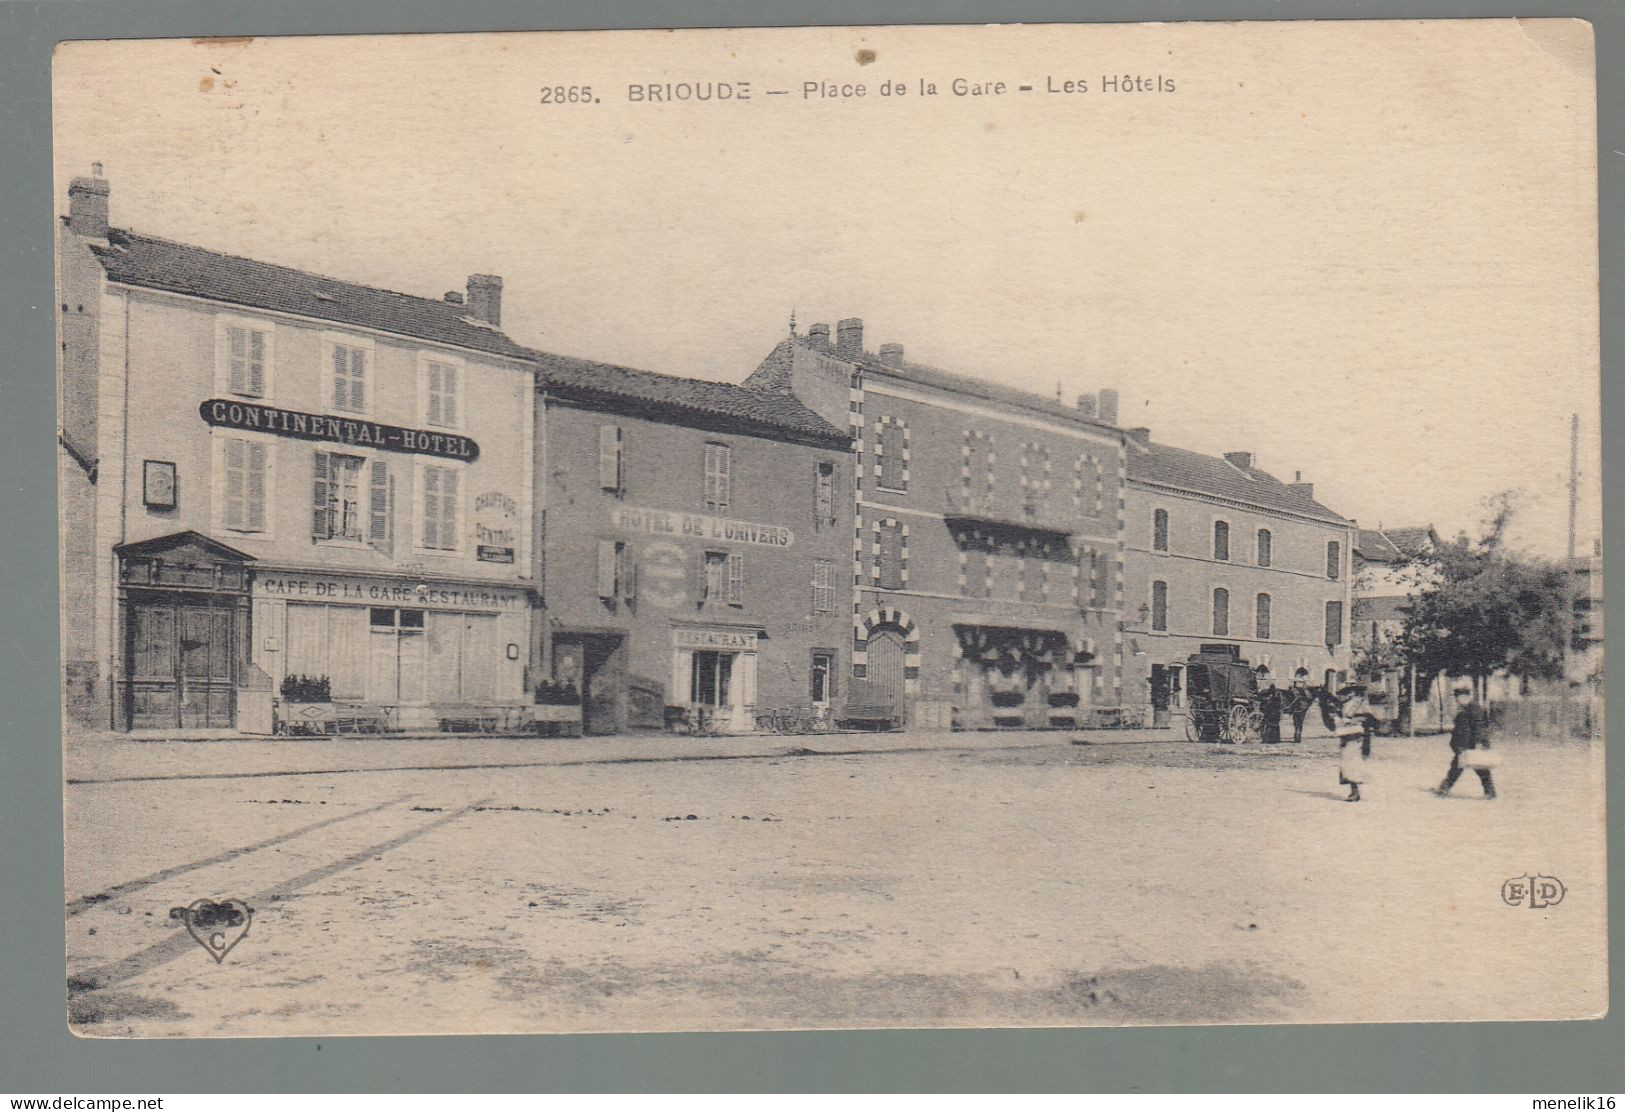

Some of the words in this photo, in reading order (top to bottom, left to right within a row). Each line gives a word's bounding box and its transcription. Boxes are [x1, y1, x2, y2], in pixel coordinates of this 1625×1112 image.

[316, 581, 338, 597] DE
[343, 583, 363, 599] LA
[370, 585, 412, 601] GARE
